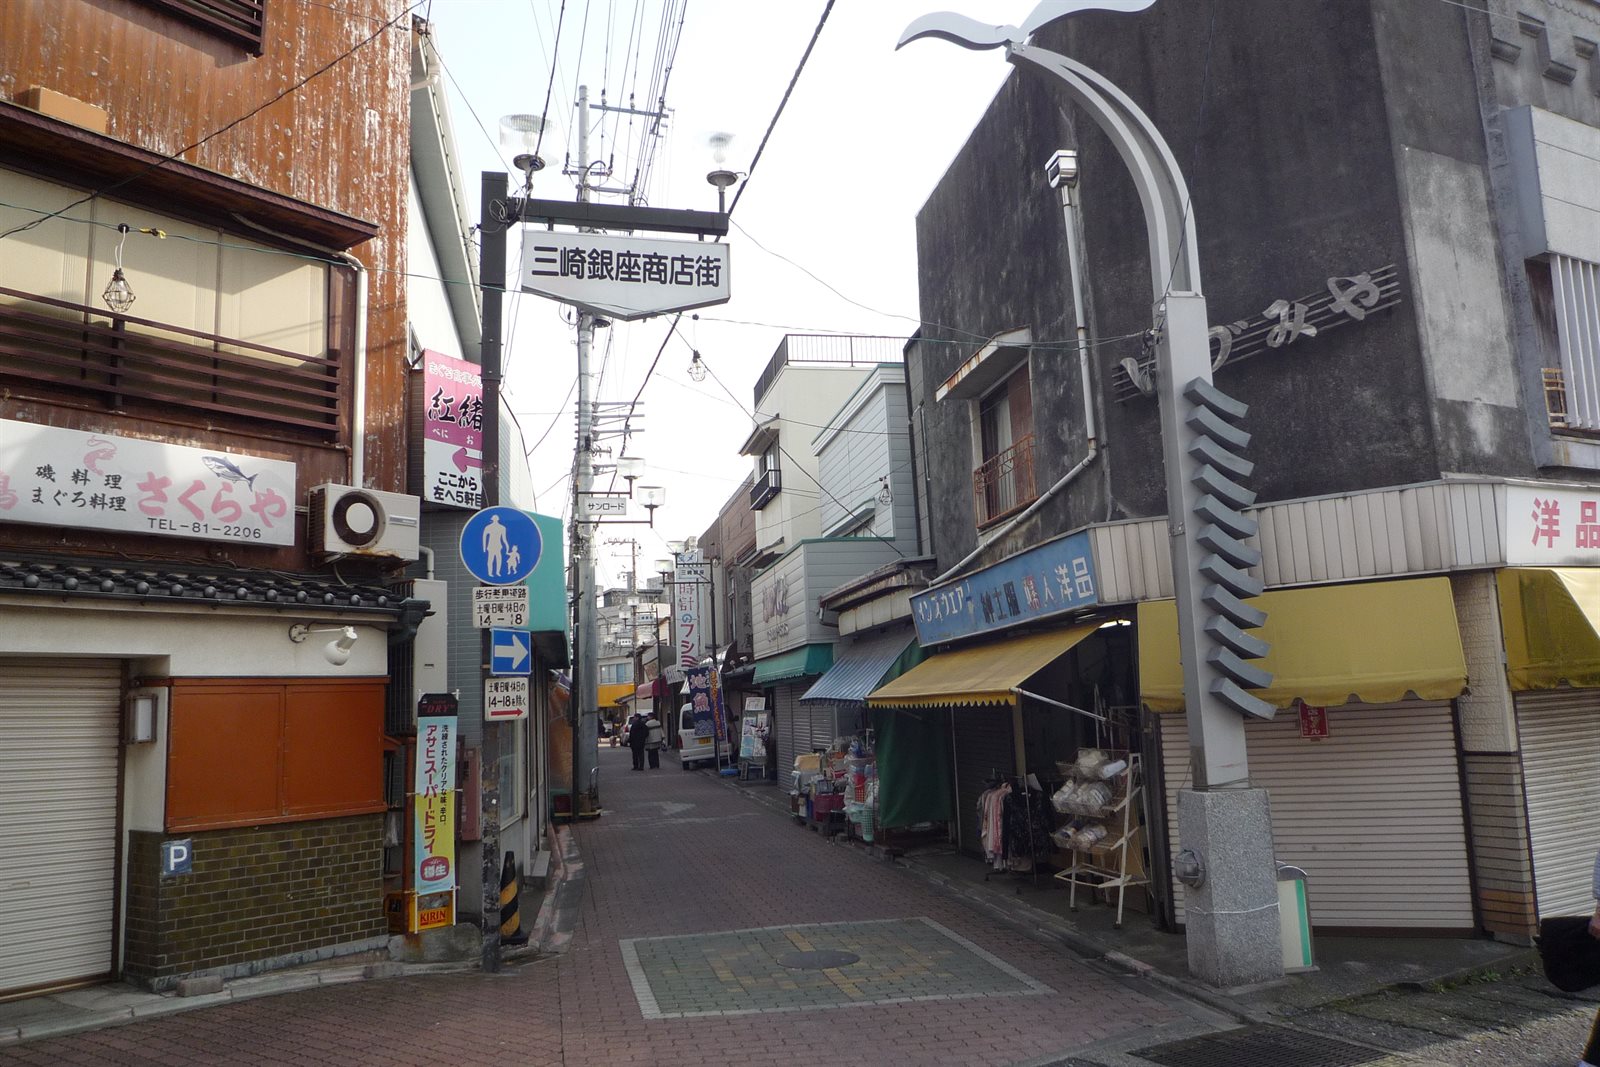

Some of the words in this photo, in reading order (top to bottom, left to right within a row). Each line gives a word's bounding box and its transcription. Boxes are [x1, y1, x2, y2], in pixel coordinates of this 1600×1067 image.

[532, 246, 721, 287] 三崎銀座商店街
[428, 387, 482, 431] 紅緒
[36, 464, 122, 490] 磯料理
[438, 472, 478, 491] ここから
[32, 487, 127, 512] まぐろ料理
[137, 471, 287, 528] さくらや
[433, 485, 482, 507] 左へ5軒目
[588, 502, 625, 511] サンロード
[1531, 497, 1600, 549] 洋品
[424, 724, 438, 854] アサヒスーパードライ
[170, 845, 188, 871] P
[420, 910, 446, 922] KIRIN
